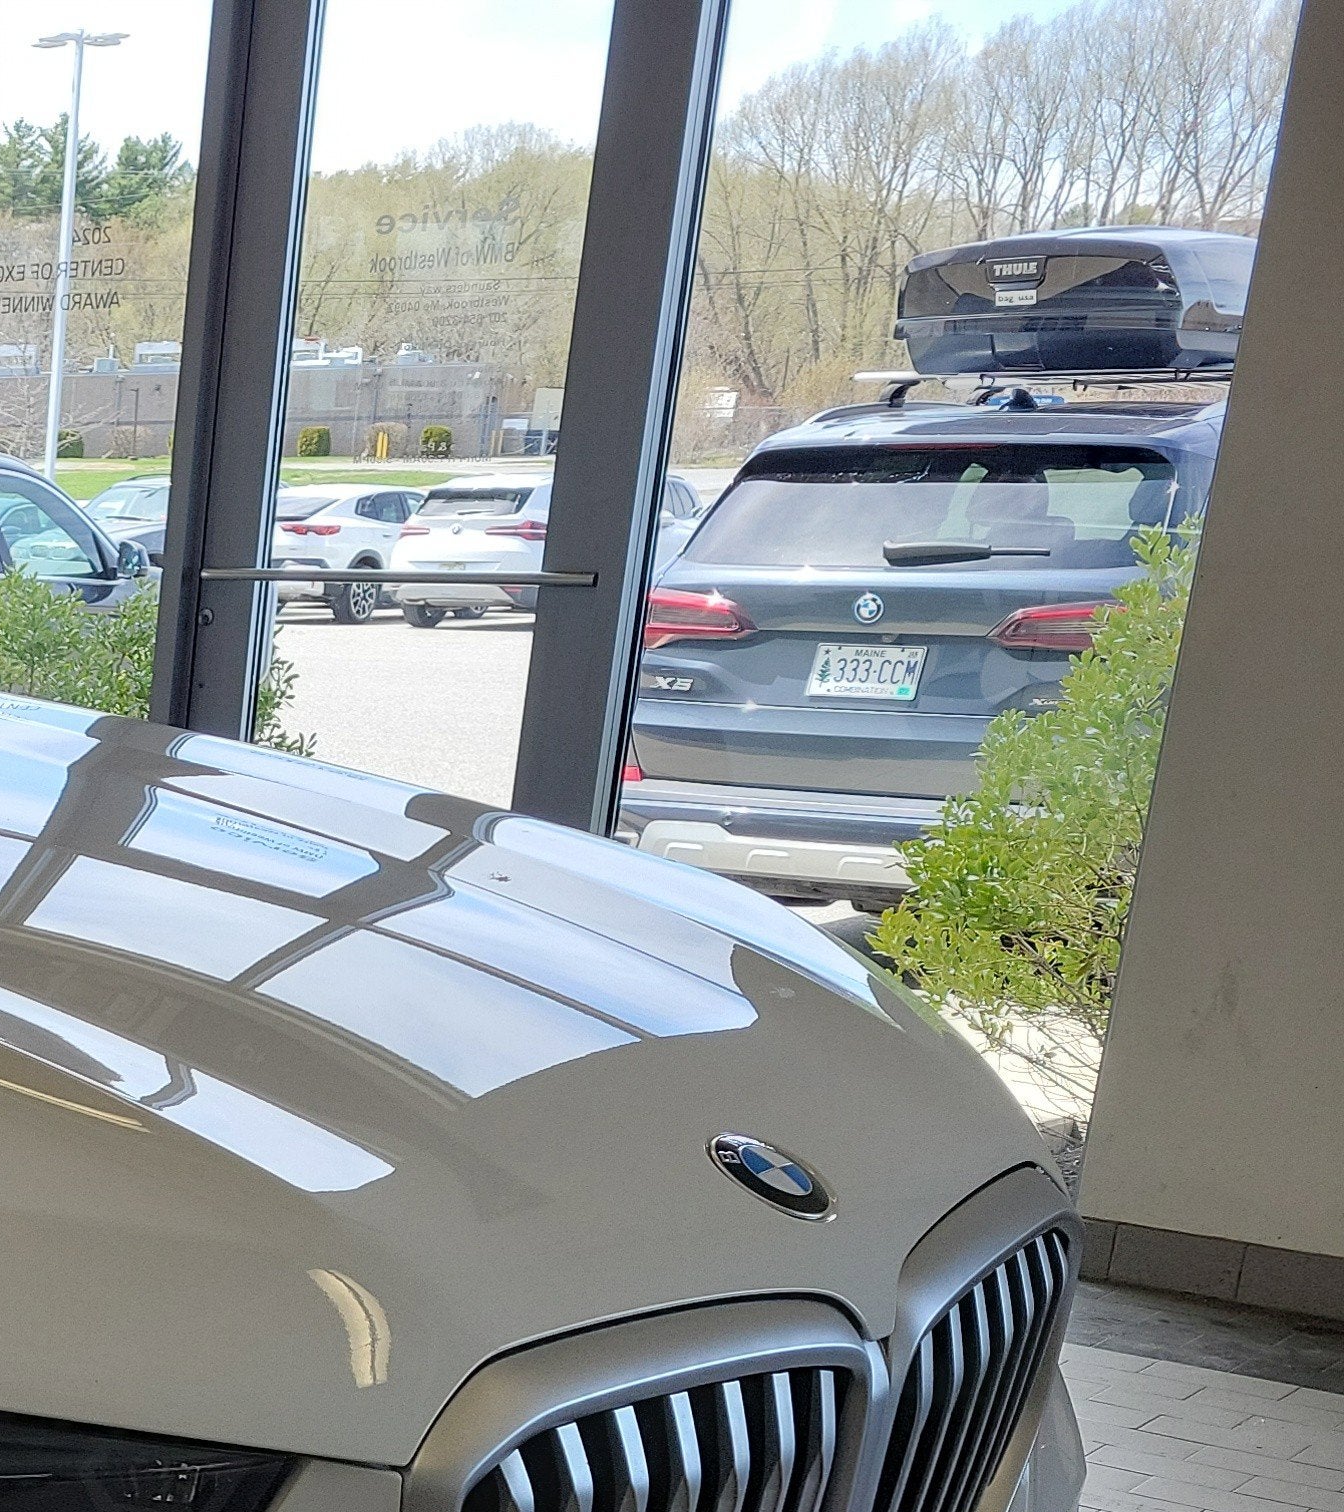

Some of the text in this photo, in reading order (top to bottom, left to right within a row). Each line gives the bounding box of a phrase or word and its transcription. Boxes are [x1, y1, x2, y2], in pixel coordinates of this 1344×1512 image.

[993, 261, 1038, 277] THULE
[854, 648, 887, 658] MAINE
[649, 676, 694, 691] X5
